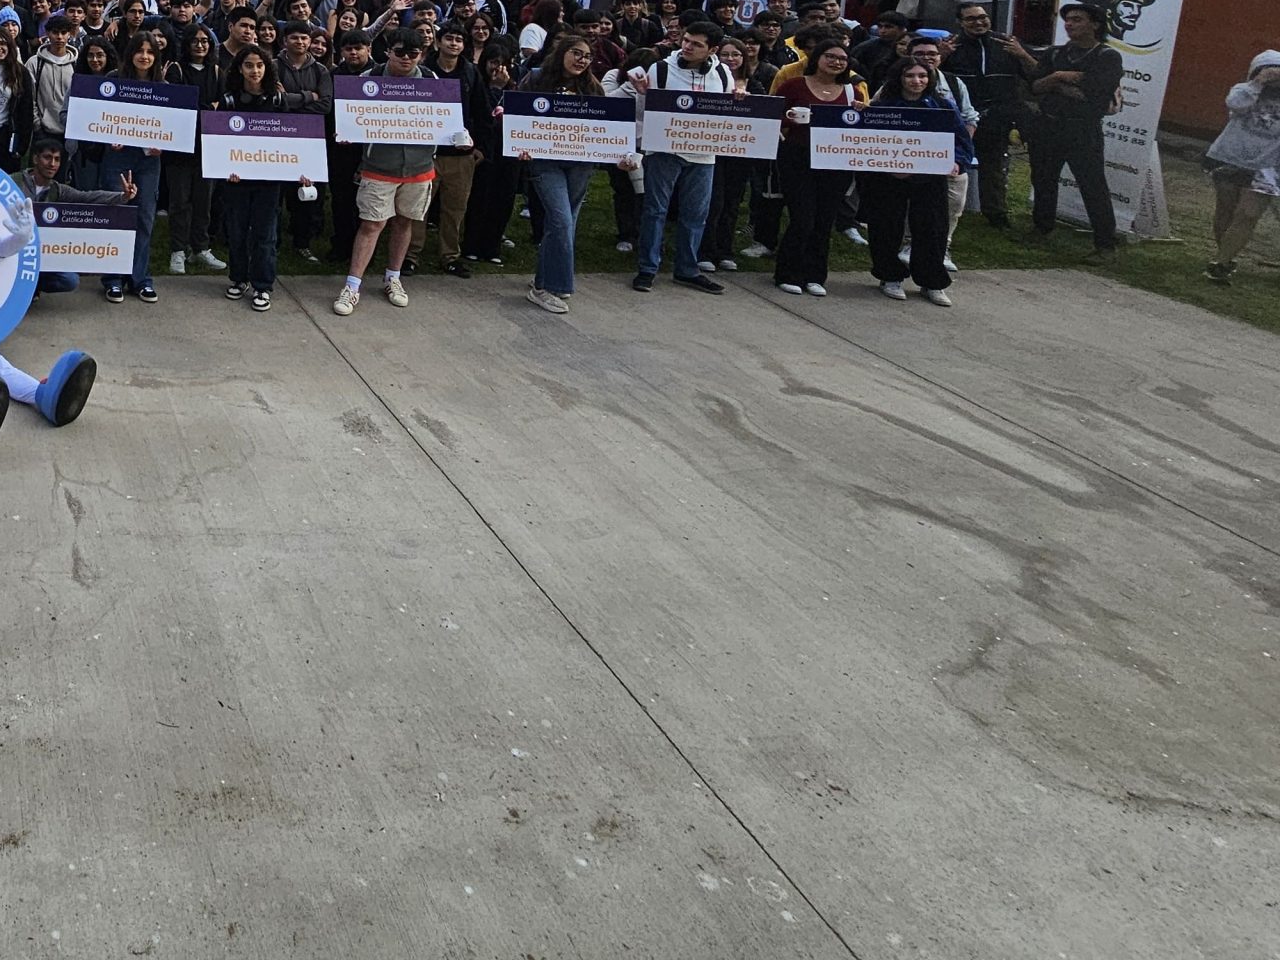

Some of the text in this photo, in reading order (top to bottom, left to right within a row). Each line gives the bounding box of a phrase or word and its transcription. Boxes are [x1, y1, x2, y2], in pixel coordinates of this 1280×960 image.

[120, 85, 152, 93] Universidad
[346, 104, 450, 116] Ingeniería Civil en
[102, 112, 161, 127] Ingeniería
[356, 116, 433, 128] Computación
[670, 118, 733, 130] Ingeniería
[88, 123, 173, 141] Civil Industrial
[533, 121, 589, 133] Pedagogía
[366, 129, 433, 140] Informática
[511, 130, 628, 145] Educación Diferencial
[740, 134, 756, 143] de
[841, 134, 903, 145] Ingeniería
[671, 141, 746, 154] Información
[816, 145, 948, 159] Información y Control
[230, 149, 298, 163] Medicina
[849, 158, 913, 169] de Gestión
[42, 242, 118, 259] nesiología
[21, 233, 37, 281] RTE
